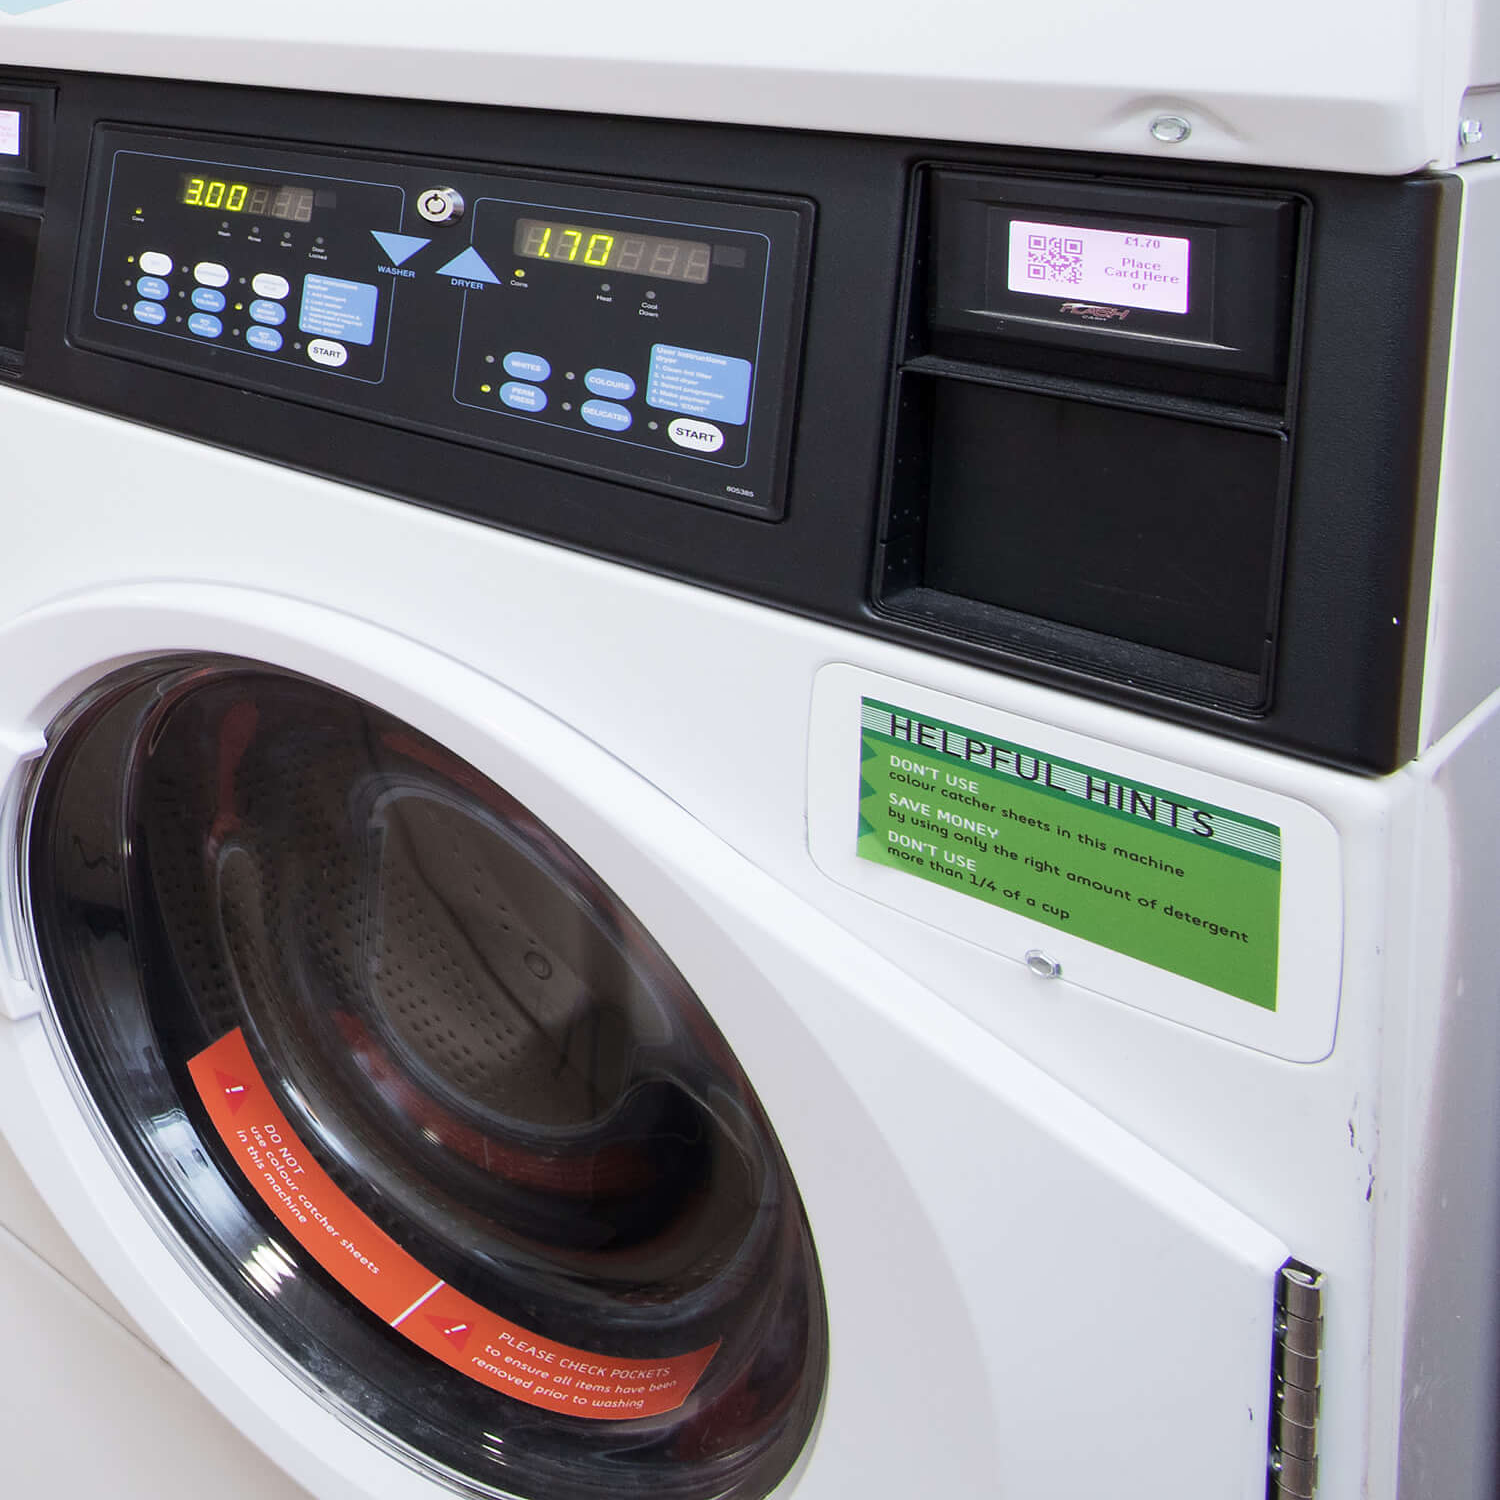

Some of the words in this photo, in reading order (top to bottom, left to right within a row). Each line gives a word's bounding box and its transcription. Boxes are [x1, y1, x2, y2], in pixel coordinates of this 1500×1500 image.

[184, 178, 248, 212] 3.00
[538, 228, 614, 267] 1.70
[1125, 236, 1160, 249] £1.70
[377, 265, 416, 278] WASHER
[451, 278, 483, 291] DRYER
[1105, 267, 1139, 279] Card
[1144, 271, 1179, 284] Here
[1122, 258, 1161, 270] Place
[312, 346, 342, 360] START
[676, 427, 715, 443] START
[889, 754, 941, 782] DON'T
[946, 772, 979, 795] USE
[889, 712, 1067, 793] HELPFUL
[1085, 773, 1215, 839] HINTS
[889, 792, 930, 818] SAVE
[936, 806, 999, 838] MONEY
[889, 770, 937, 794] colour
[940, 785, 996, 814] catcher
[1001, 807, 1052, 833] sheets
[1057, 823, 1072, 837] in
[1076, 831, 1107, 851] this
[1112, 845, 1185, 878] machine
[888, 829, 938, 857] DON'T
[944, 848, 977, 872] USE
[887, 844, 925, 865] more
[929, 857, 965, 880] than
[970, 871, 997, 892] 1/4
[1003, 885, 1023, 901] of
[1026, 895, 1037, 906] a
[1042, 899, 1070, 921] cup
[888, 806, 906, 823] by
[910, 817, 949, 838] using
[953, 829, 988, 852] only
[993, 843, 1019, 862] the
[1024, 854, 1061, 879] right
[1066, 868, 1131, 902] amount
[1137, 892, 1158, 910] of
[1163, 903, 1250, 944] detergent
[264, 1124, 282, 1144] DO
[279, 1147, 305, 1176] NOT
[236, 1130, 247, 1142] in
[247, 1146, 264, 1169] this
[264, 1173, 307, 1223] machine
[250, 1126, 267, 1148] use
[266, 1151, 299, 1192] colour
[298, 1194, 340, 1237] catcher
[340, 1239, 380, 1274] sheets
[498, 1332, 555, 1364] PLEASE
[559, 1358, 606, 1376] CHECK
[610, 1367, 671, 1379] POCKETS
